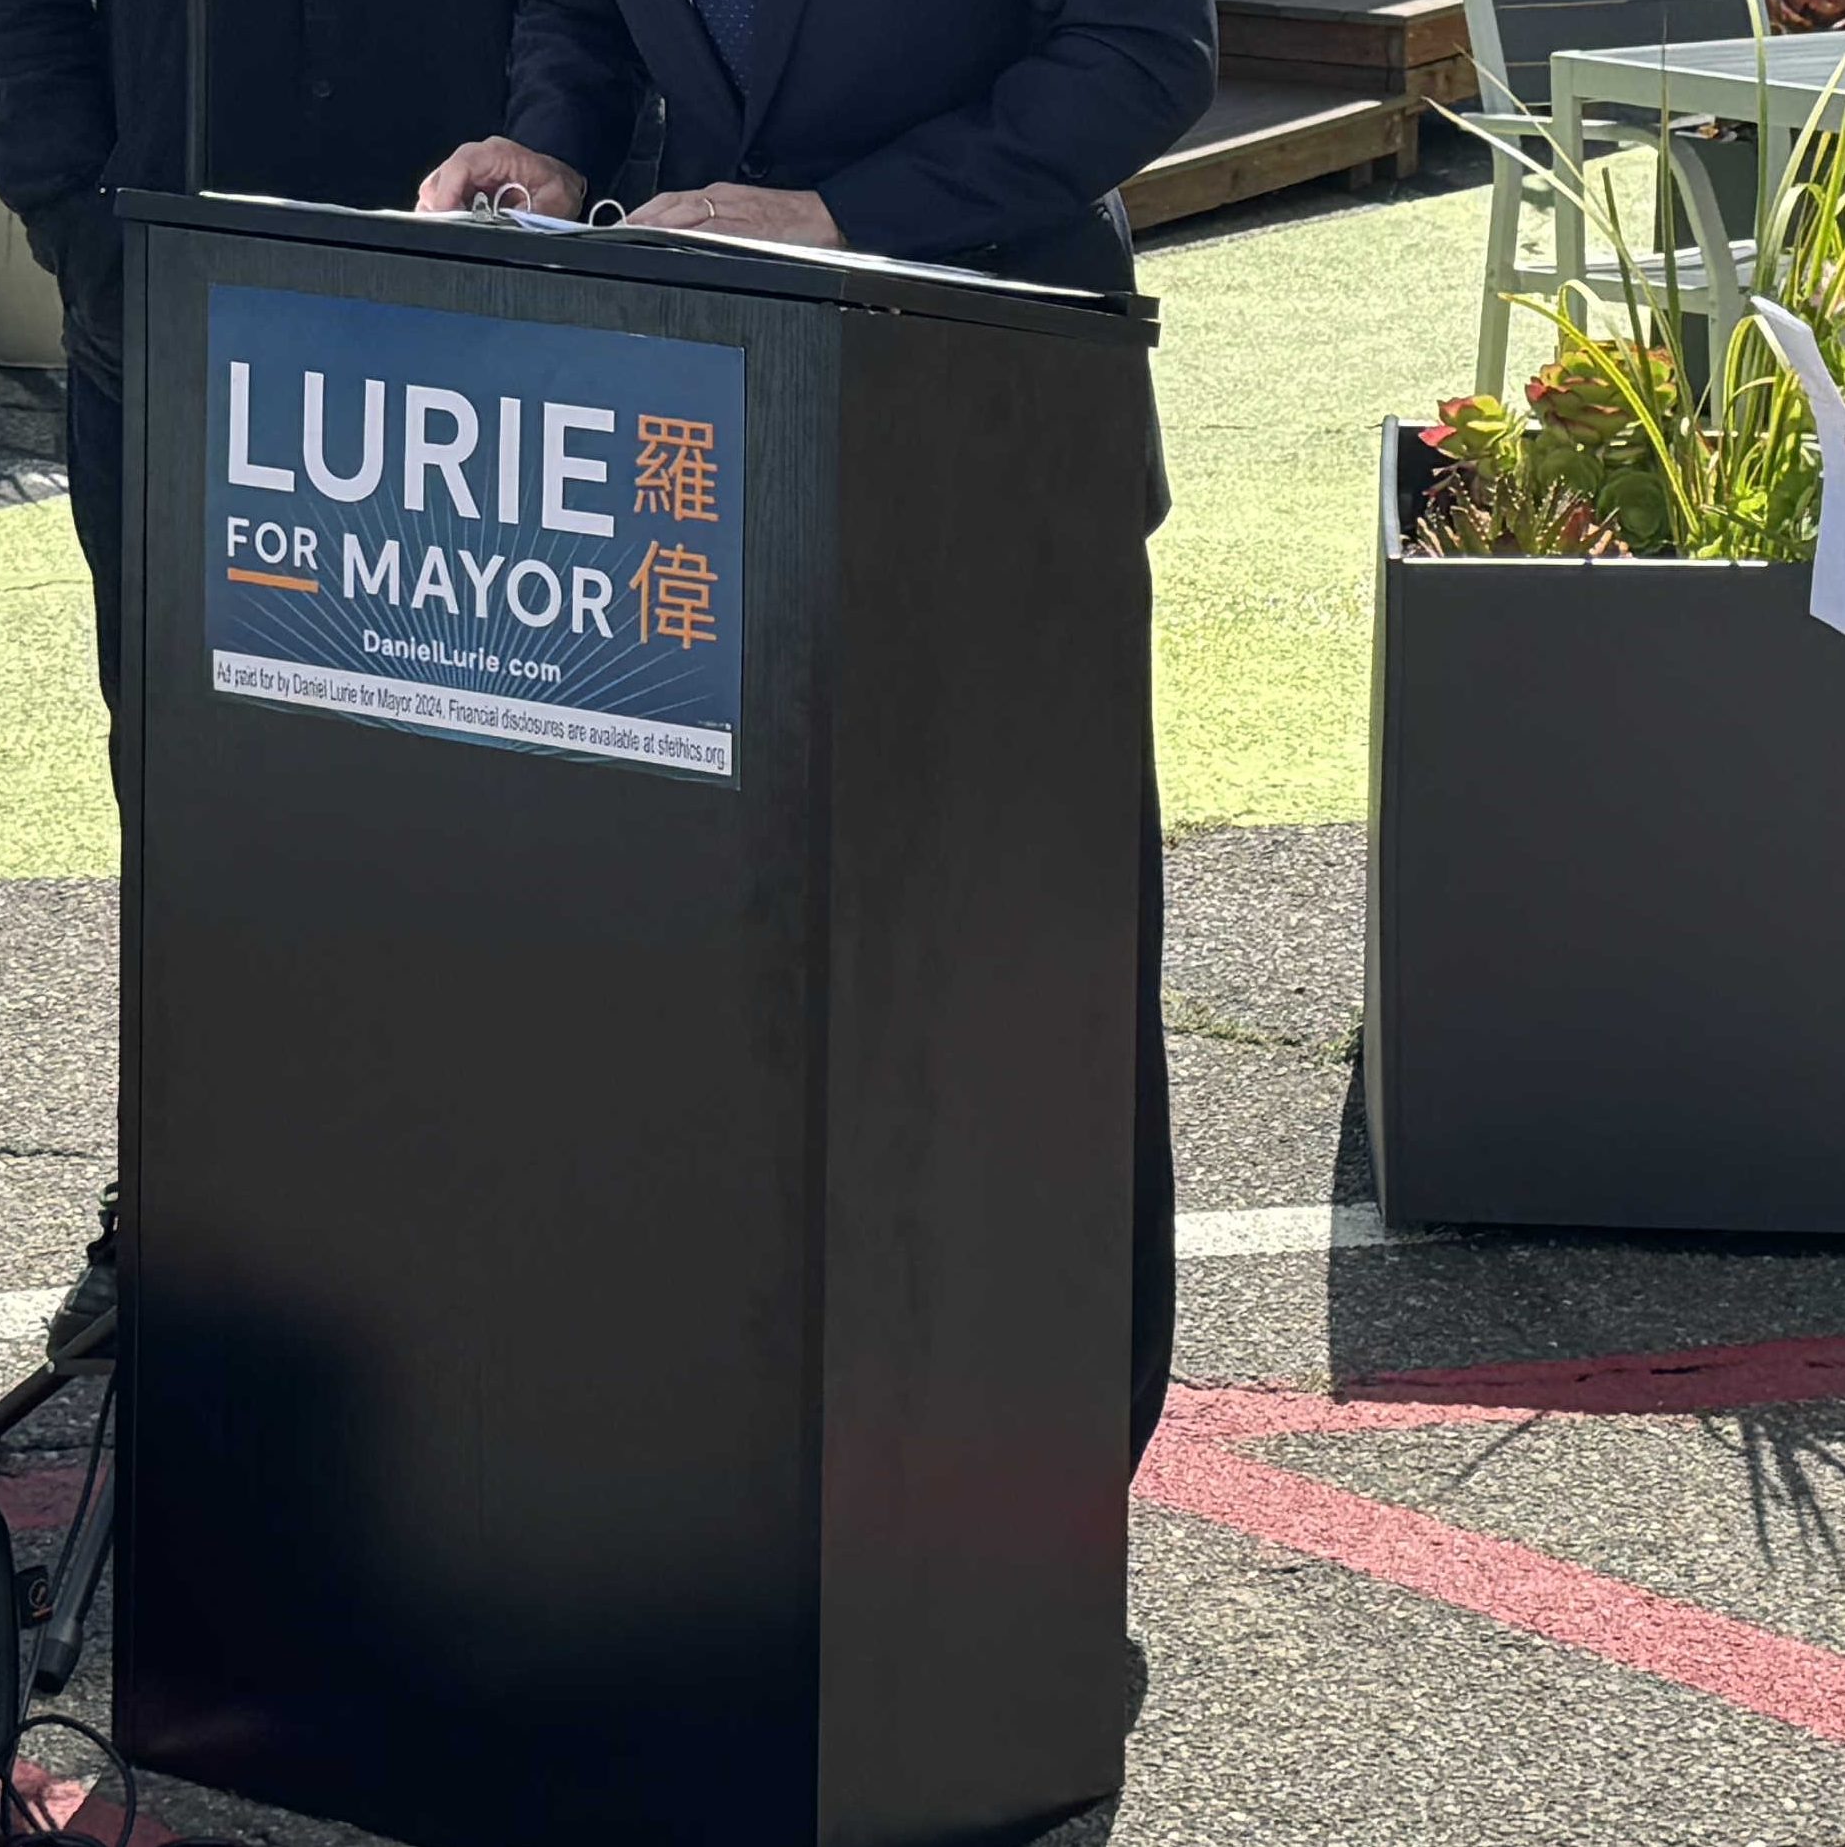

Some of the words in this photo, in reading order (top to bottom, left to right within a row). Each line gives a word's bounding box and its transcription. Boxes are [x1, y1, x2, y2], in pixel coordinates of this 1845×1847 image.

[227, 361, 615, 538] LURIE
[227, 516, 318, 571] FOR
[342, 533, 614, 639] MAYOR
[629, 414, 719, 649] 羅偉
[363, 630, 562, 682] DanielLurie.com
[277, 671, 291, 696] by
[293, 674, 327, 699] Daniel
[330, 681, 357, 704] Lurie
[360, 684, 375, 705] for
[377, 688, 413, 716] Mayor
[415, 693, 446, 719] 2024.
[448, 699, 499, 728] Financial
[501, 709, 565, 738] disclosures
[567, 723, 587, 742] are
[589, 725, 640, 751] available
[643, 733, 655, 753] at
[657, 734, 725, 771] sfethics.org
